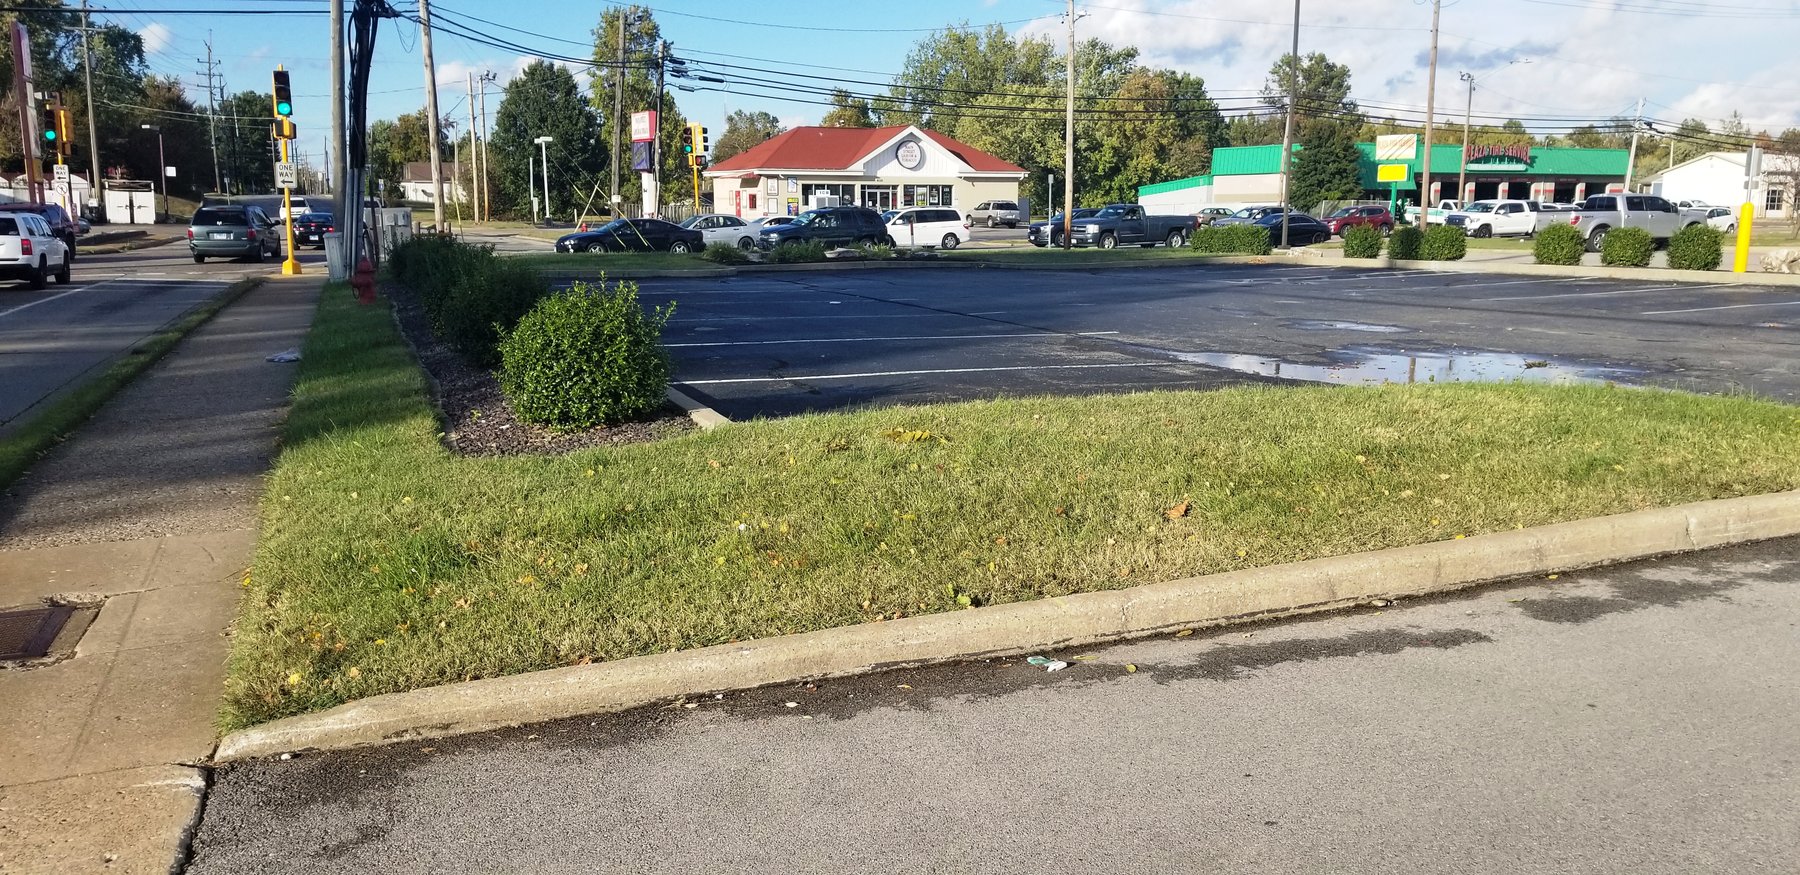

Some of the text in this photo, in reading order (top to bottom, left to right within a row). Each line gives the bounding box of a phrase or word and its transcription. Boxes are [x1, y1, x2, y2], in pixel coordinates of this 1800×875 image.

[1466, 144, 1530, 163] PLAZA TIRE SERVICE
